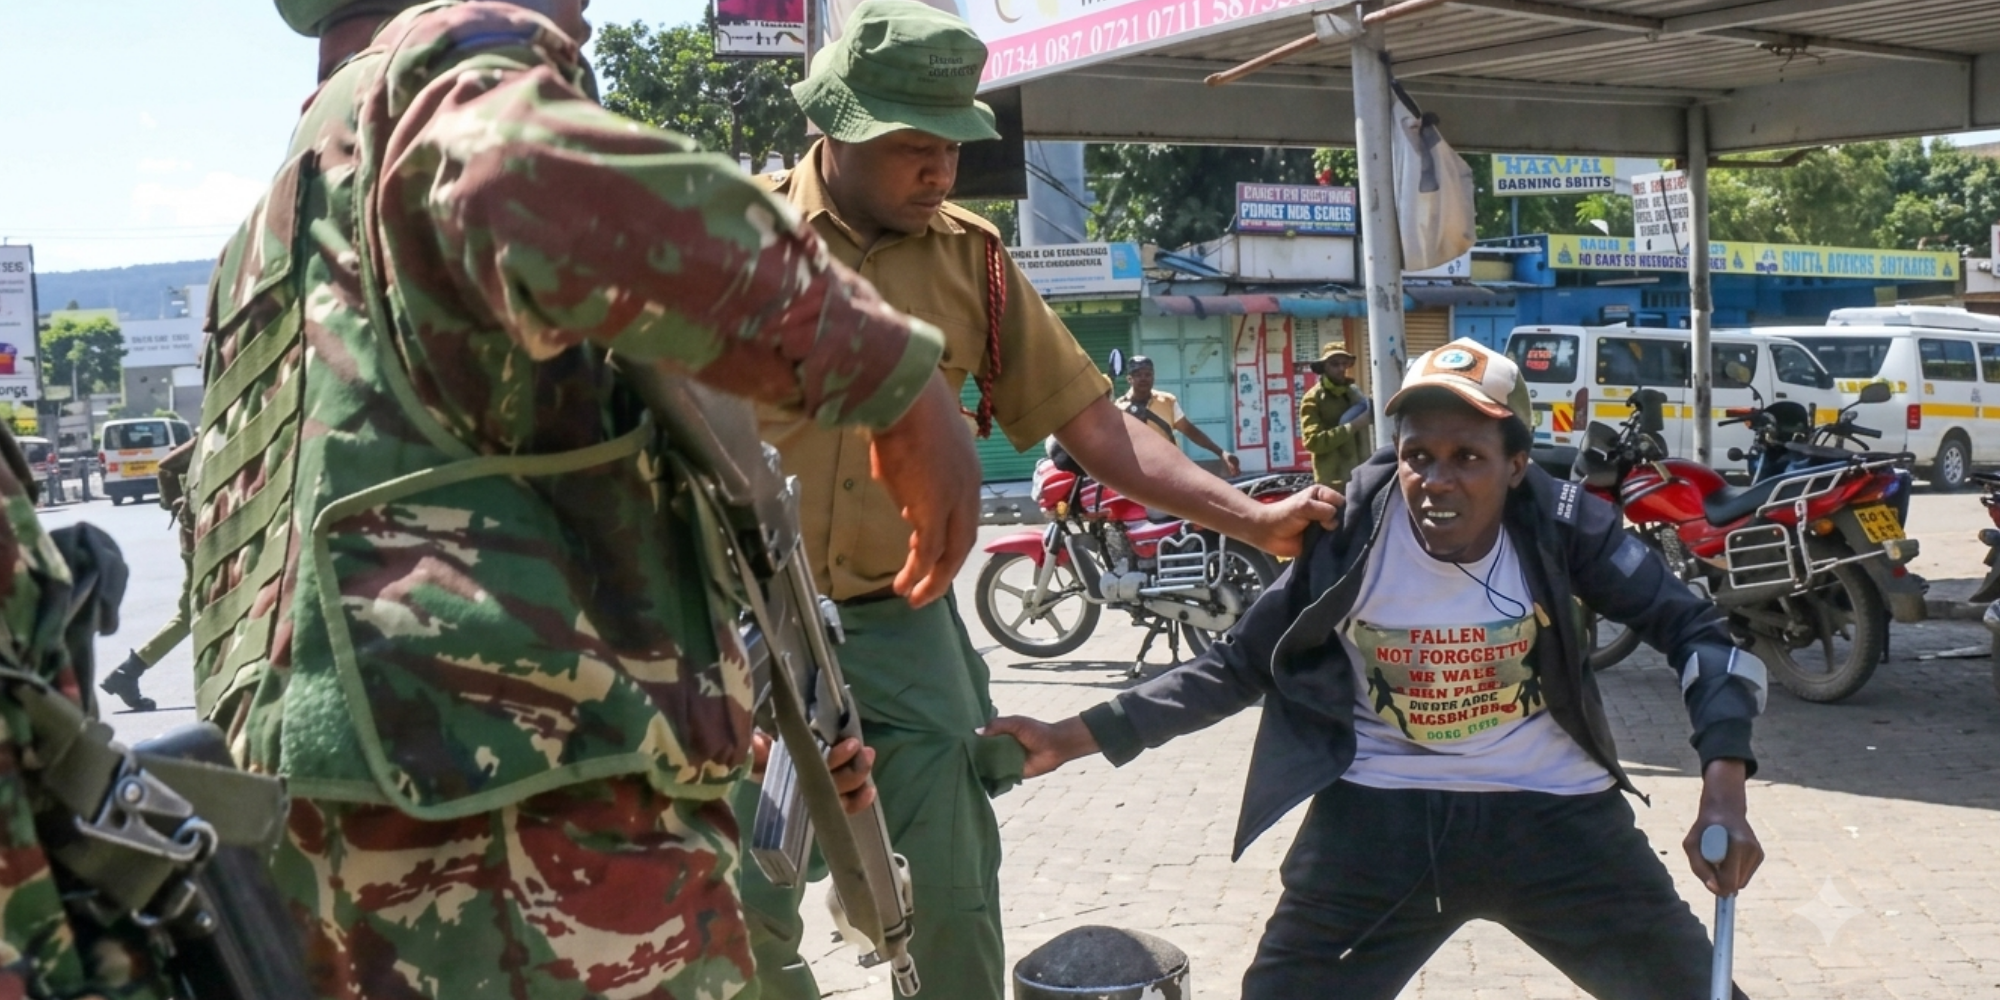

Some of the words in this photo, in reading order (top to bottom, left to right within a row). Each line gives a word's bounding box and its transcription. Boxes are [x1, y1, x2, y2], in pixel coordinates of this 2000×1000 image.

[991, 42, 1038, 79] 0734
[1045, 30, 1083, 65] 087
[1090, 13, 1139, 54] 0721
[1147, 1, 1201, 38] 0711
[1410, 628, 1485, 644] FALLEN
[1376, 647, 1413, 664] NOT
